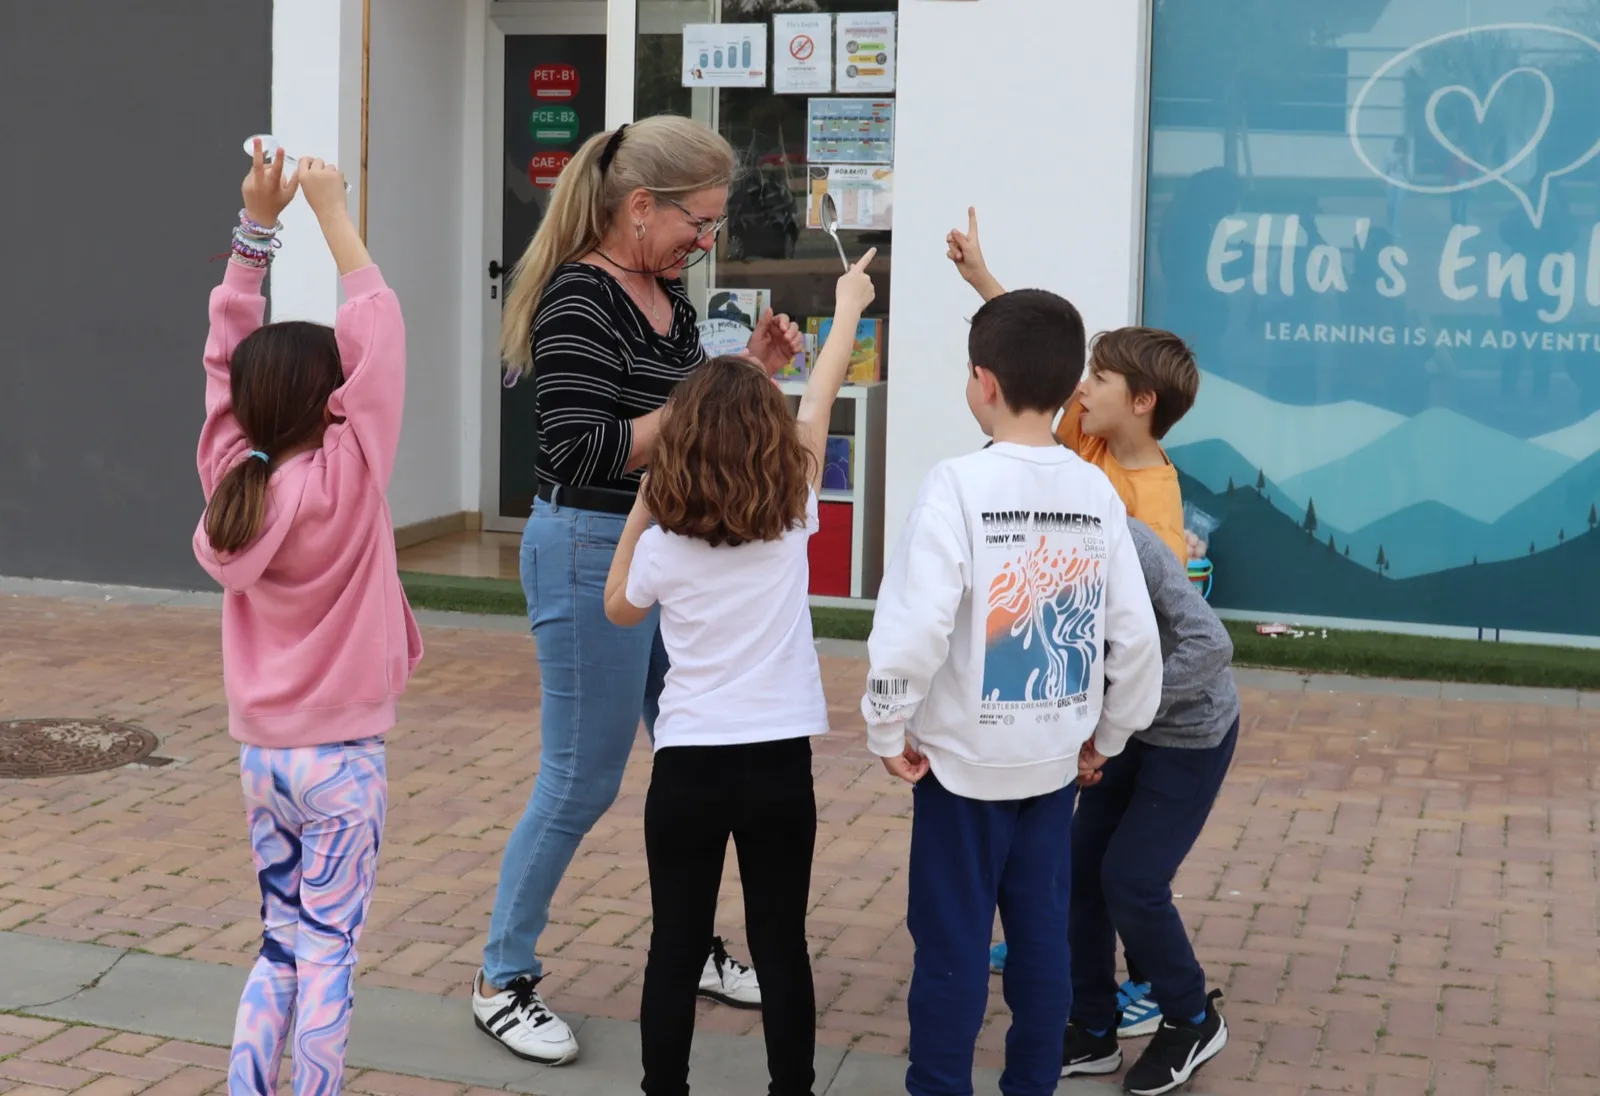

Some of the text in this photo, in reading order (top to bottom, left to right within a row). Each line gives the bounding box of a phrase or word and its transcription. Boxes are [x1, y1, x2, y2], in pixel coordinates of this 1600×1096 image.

[532, 157, 569, 167] CAE-C
[1206, 213, 1409, 298] Ella's
[1265, 321, 1396, 344] LEARNING
[1403, 327, 1427, 346] IS
[1434, 328, 1472, 348] AN
[985, 534, 1010, 544] FUNNY
[981, 702, 1019, 711] RESTLESS
[1020, 701, 1054, 710] DREAMER
